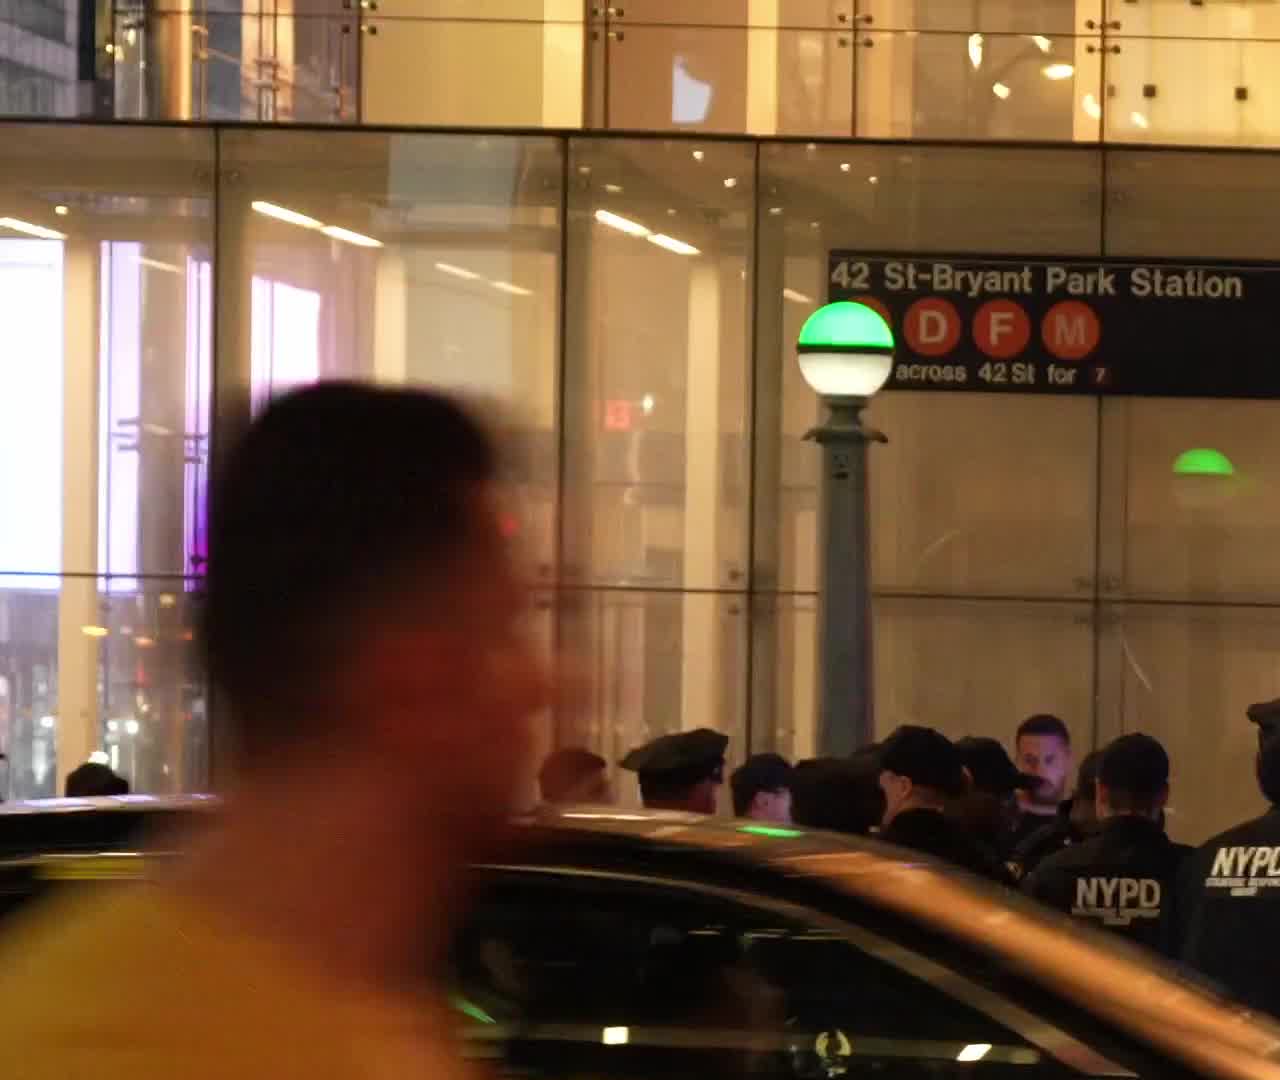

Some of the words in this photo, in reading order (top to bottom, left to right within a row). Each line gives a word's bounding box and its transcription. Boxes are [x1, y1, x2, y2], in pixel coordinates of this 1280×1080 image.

[831, 262, 870, 290] 42
[884, 262, 1032, 298] St-Bryant
[1046, 267, 1116, 296] Park
[1130, 268, 1243, 298] Station
[918, 311, 948, 344] D
[989, 312, 1013, 344] F
[1055, 314, 1087, 347] M
[896, 364, 967, 383] across
[978, 362, 1007, 383] 42
[1011, 363, 1036, 384] St
[1047, 364, 1077, 384] for
[1076, 876, 1161, 908] NYPD
